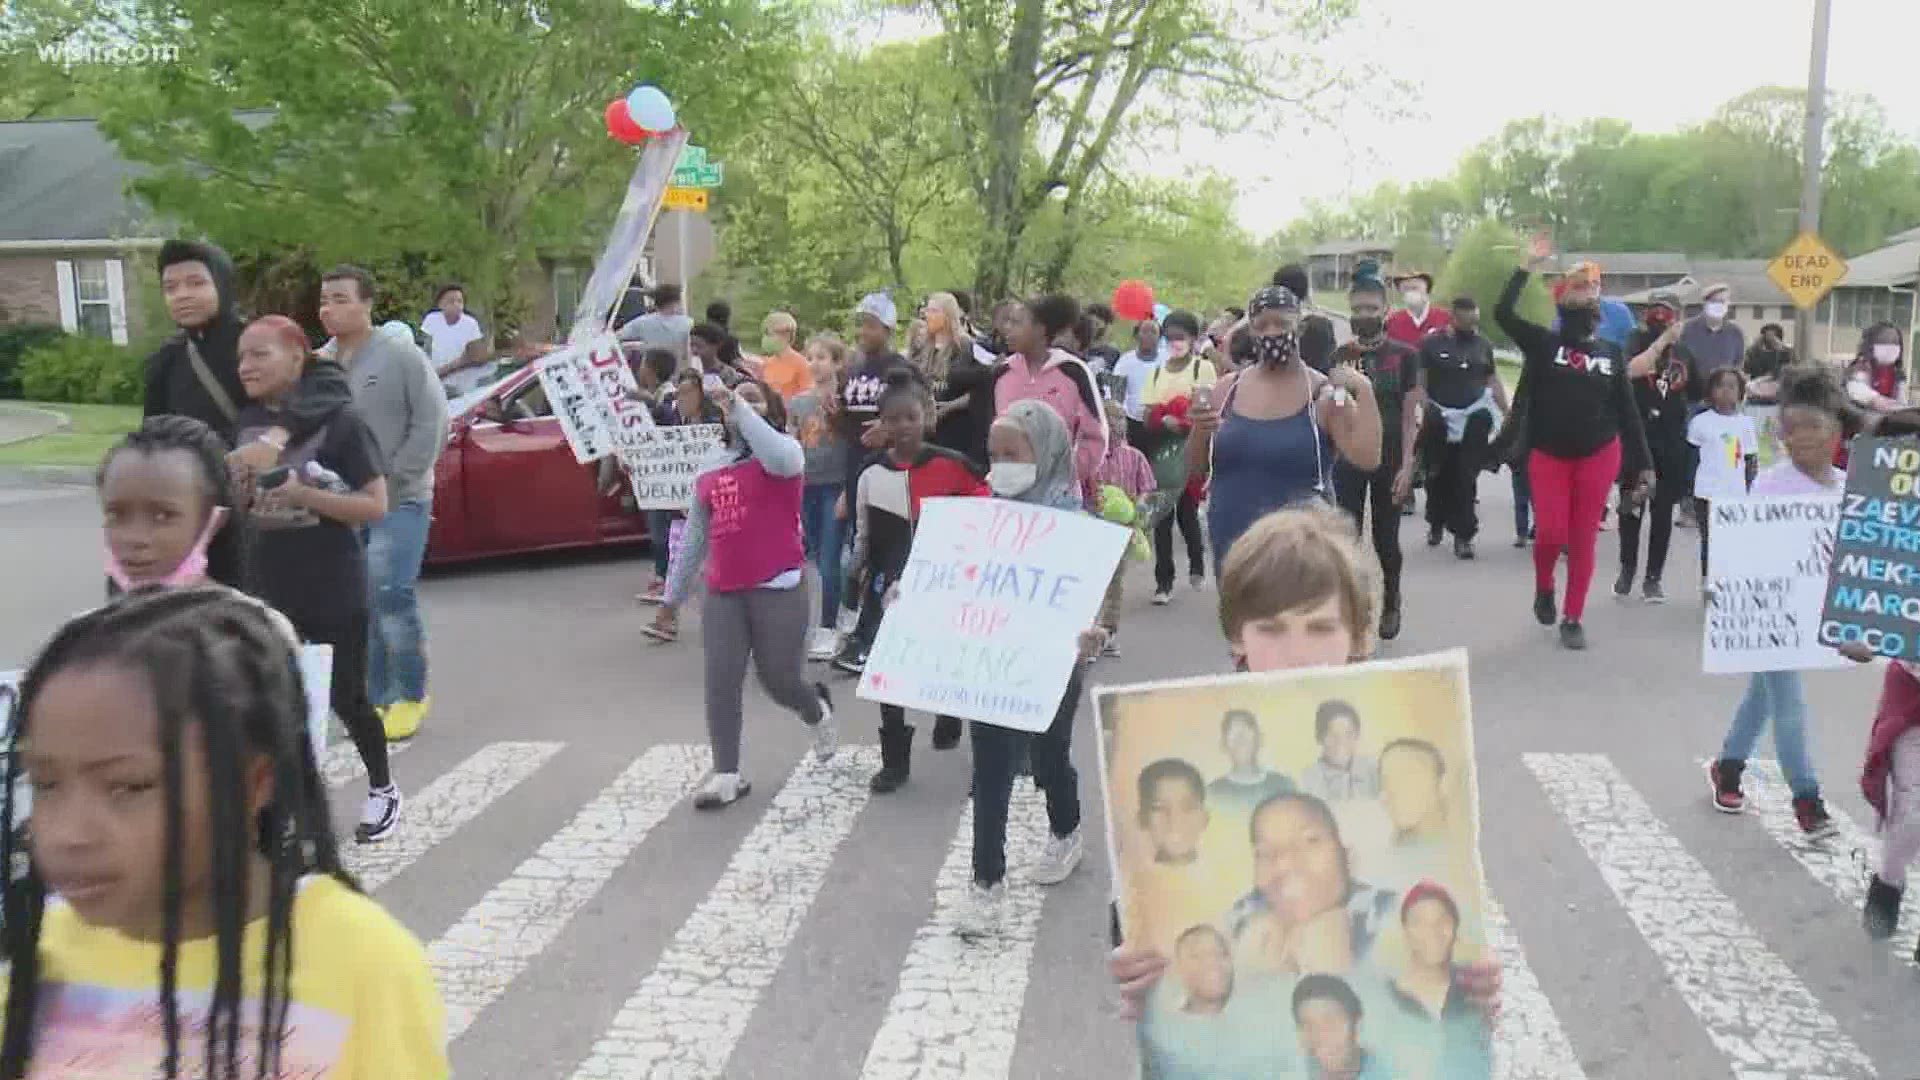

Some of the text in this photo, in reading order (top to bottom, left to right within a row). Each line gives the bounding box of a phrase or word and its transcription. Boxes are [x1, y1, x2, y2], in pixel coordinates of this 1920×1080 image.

[1784, 255, 1829, 268] DEAD
[1791, 274, 1822, 287] END
[1874, 447, 1920, 472] NO
[1843, 493, 1920, 524] ZAEV
[912, 559, 962, 593] THE
[976, 559, 1081, 608] HATE
[1710, 632, 1802, 651] VIOLENCE
[1822, 621, 1904, 655] COCO
